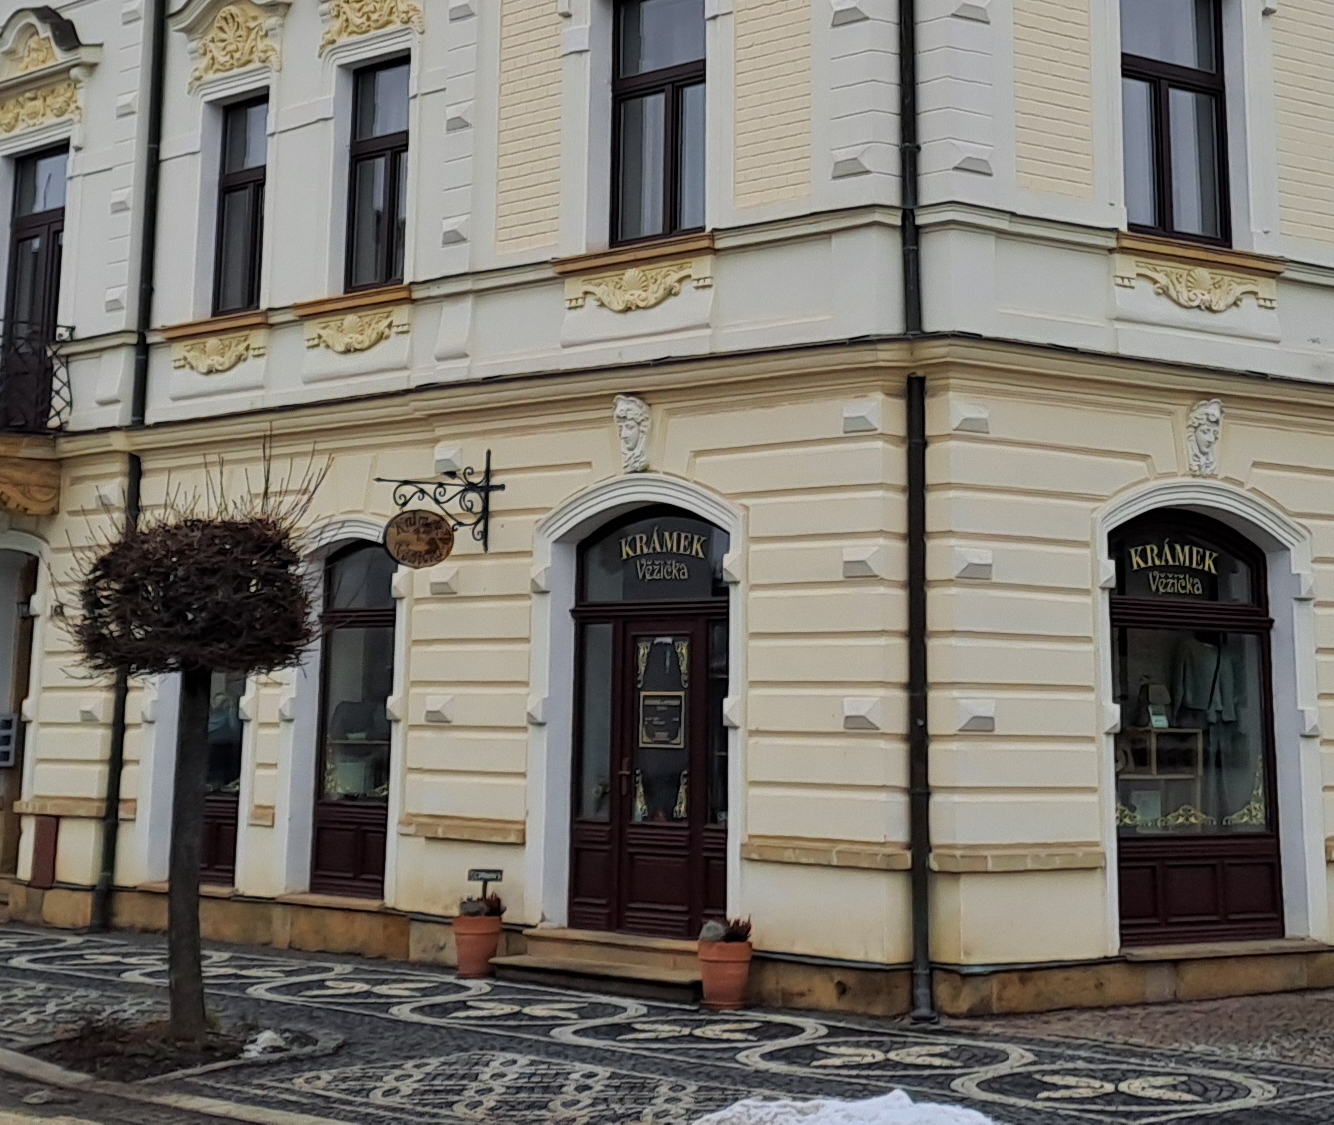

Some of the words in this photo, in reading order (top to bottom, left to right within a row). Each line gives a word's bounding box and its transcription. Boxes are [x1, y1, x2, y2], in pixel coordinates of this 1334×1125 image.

[619, 525, 707, 560] KRÁMEK
[1129, 537, 1219, 574] KRÁMEK
[636, 557, 689, 582] Věžička
[1148, 570, 1203, 595] Věžička
